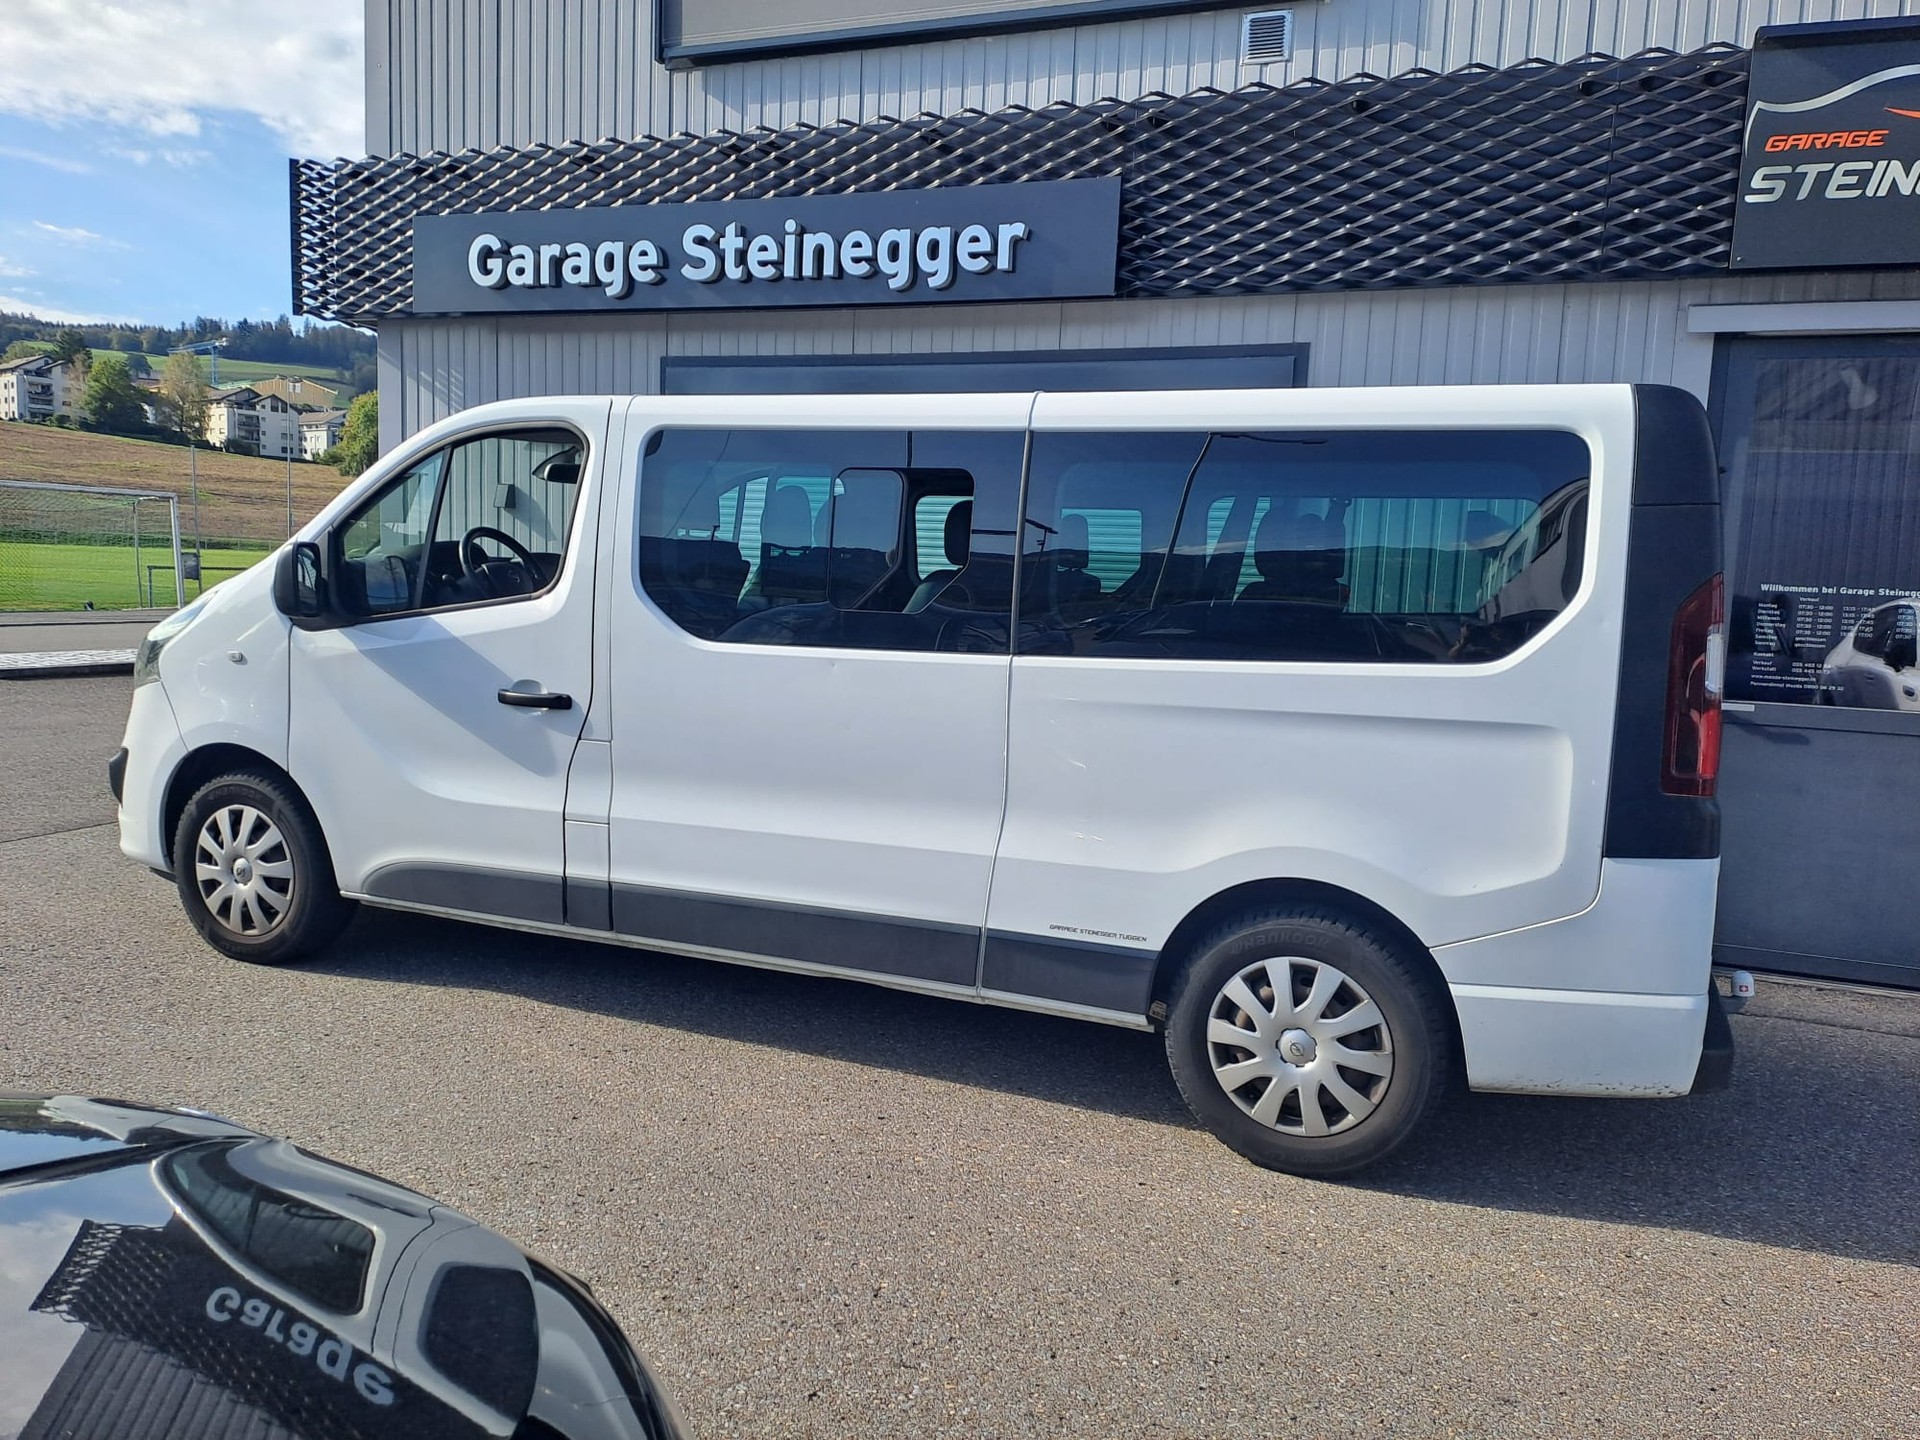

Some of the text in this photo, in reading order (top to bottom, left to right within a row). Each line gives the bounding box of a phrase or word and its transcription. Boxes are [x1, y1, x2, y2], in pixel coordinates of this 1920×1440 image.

[1764, 129, 1889, 152] GARAGE
[1744, 159, 1920, 203] STEIN
[467, 219, 1027, 298] Garage Steinegger
[1760, 583, 1819, 593] Willkommen
[1821, 586, 1836, 594] bei
[1840, 587, 1875, 596] Garage
[1049, 924, 1148, 942] GARAGE STEINEGGER TUGGEN
